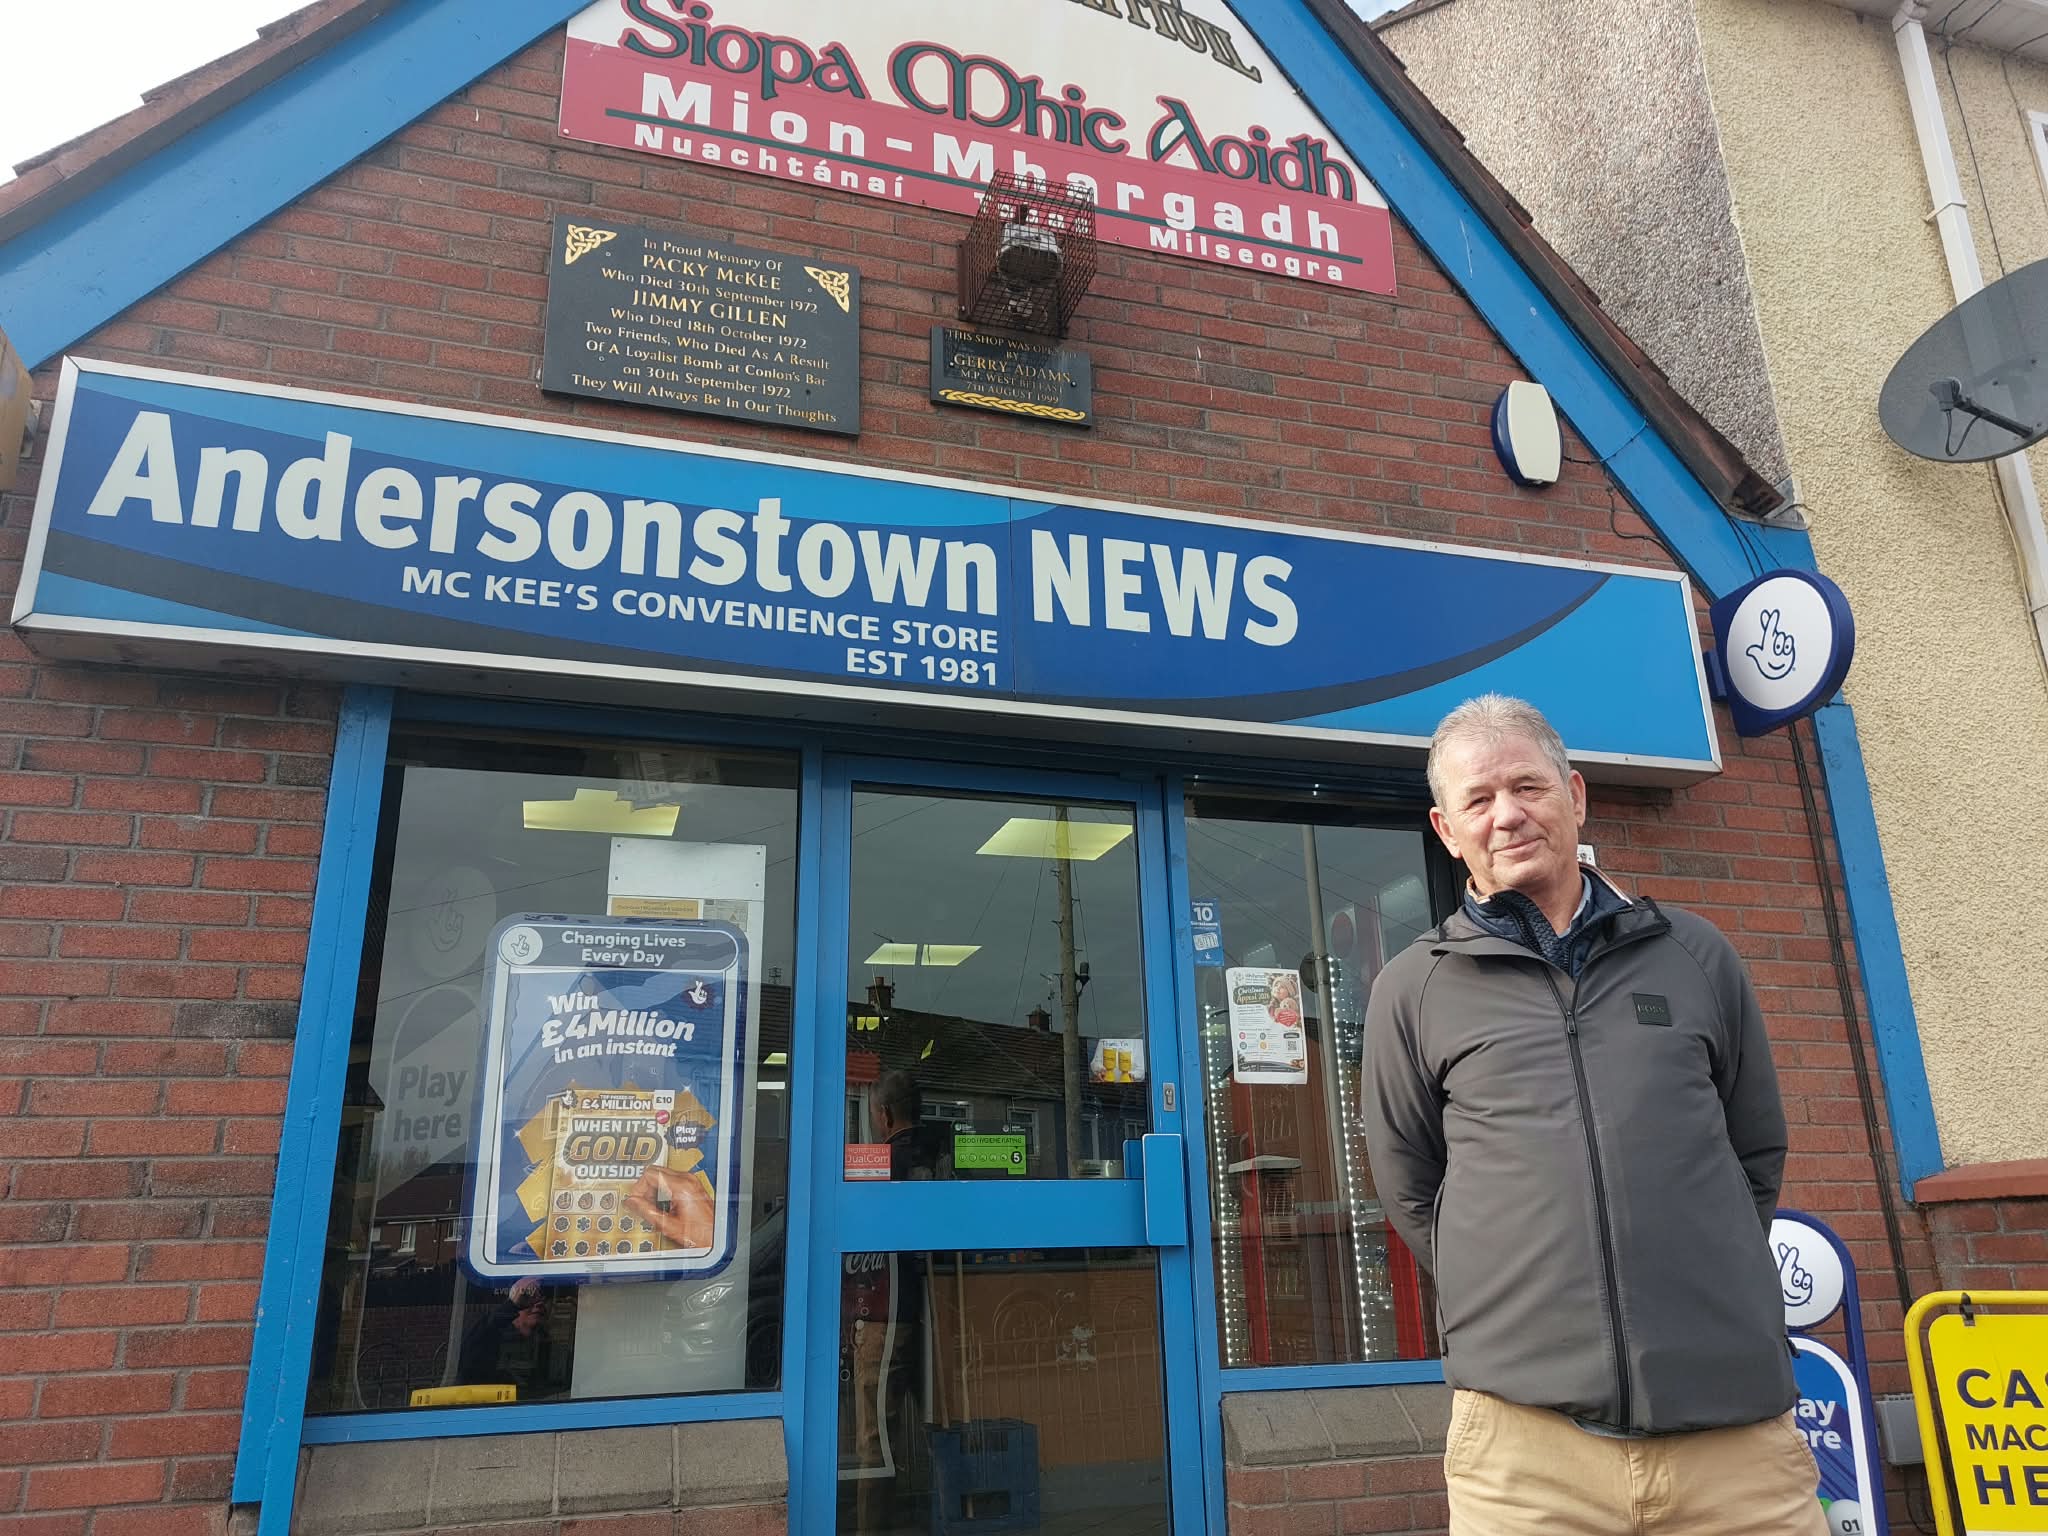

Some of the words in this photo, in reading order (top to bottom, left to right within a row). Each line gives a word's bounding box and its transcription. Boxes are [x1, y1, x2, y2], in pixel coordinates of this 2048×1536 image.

[617, 0, 873, 101] Siopa
[886, 40, 1131, 155] Mhic
[1145, 95, 1359, 203] Aoidh
[634, 123, 904, 198] Nuachtánaí
[642, 237, 657, 250] In
[662, 241, 702, 258] Proud
[706, 248, 761, 271] Memory
[765, 257, 785, 272] Of
[1149, 225, 1344, 281] Milseogra
[641, 254, 710, 278] PACKY
[716, 268, 782, 291] McKEE
[601, 267, 635, 284] Who
[639, 273, 673, 291] Died
[677, 279, 711, 297] 30th
[714, 287, 786, 310] September
[790, 299, 819, 315] 1972
[632, 289, 705, 315] JIMMY
[709, 303, 789, 329] GILLEN
[610, 307, 645, 323] Who
[649, 314, 683, 330] Died
[687, 319, 716, 335] 18th
[720, 325, 774, 345] October
[777, 334, 808, 350] 1972
[948, 329, 973, 342] THIS
[975, 334, 1005, 347] SHOP
[1007, 339, 1030, 352] WAS
[584, 320, 613, 336] Two
[616, 327, 672, 347] Friends,
[676, 335, 710, 352] Who
[714, 341, 747, 358] Died
[751, 348, 769, 361] As
[773, 351, 785, 364] A
[789, 353, 832, 370] Result
[1006, 351, 1019, 361] BY
[585, 339, 605, 352] Of
[608, 343, 620, 356] A
[625, 346, 678, 365] Loyalist
[682, 354, 724, 371] Bomb
[727, 363, 740, 374] at
[744, 364, 801, 384] Conlon's
[805, 373, 828, 387] Bar
[953, 353, 1008, 373] GERRY
[1014, 364, 1072, 384] ADAMS
[622, 365, 641, 377] on
[646, 367, 680, 383] 30th
[685, 372, 758, 395] September
[761, 383, 793, 399] 1972
[986, 373, 1016, 386] WEST
[1019, 379, 1065, 395] BELFAST
[988, 384, 1033, 401] AUGUST
[1036, 393, 1060, 405] 1999
[571, 374, 608, 392] They
[611, 379, 642, 395] Will
[646, 385, 699, 404] Always
[703, 394, 722, 407] Be
[725, 397, 740, 409] In
[744, 401, 772, 415] Our
[774, 404, 838, 425] Thoughts
[86, 410, 999, 617] Andersonstown
[1031, 529, 1300, 647] NEWS
[401, 566, 472, 599] MC
[484, 575, 599, 612] KEE'S
[612, 588, 881, 642] CONVENIENCE
[891, 619, 999, 654] STORE
[846, 647, 909, 677] EST
[919, 655, 998, 686] 1981
[1193, 906, 1213, 922] 10
[561, 930, 642, 950] Changing
[643, 933, 687, 949] Lives
[581, 948, 630, 966] Every
[632, 950, 665, 967] Day
[547, 991, 599, 1016] Win
[554, 1046, 575, 1064] in
[577, 1042, 603, 1058] an
[605, 1038, 678, 1058] instant
[399, 1064, 470, 1106] Play
[581, 1098, 600, 1110] £4
[601, 1098, 651, 1111] MILLION
[655, 1096, 673, 1105] £10
[393, 1109, 463, 1143] here
[573, 1119, 624, 1134] WHEN
[626, 1119, 659, 1134] IT'S
[675, 1125, 697, 1137] Play
[675, 1135, 697, 1145] now
[569, 1135, 659, 1162] GOLD
[1013, 1152, 1021, 1164] 5
[576, 1164, 644, 1180] OUTSIDE
[1956, 1368, 2048, 1409] CA
[1792, 1398, 1836, 1427] ay
[1842, 1519, 1861, 1533] 01
